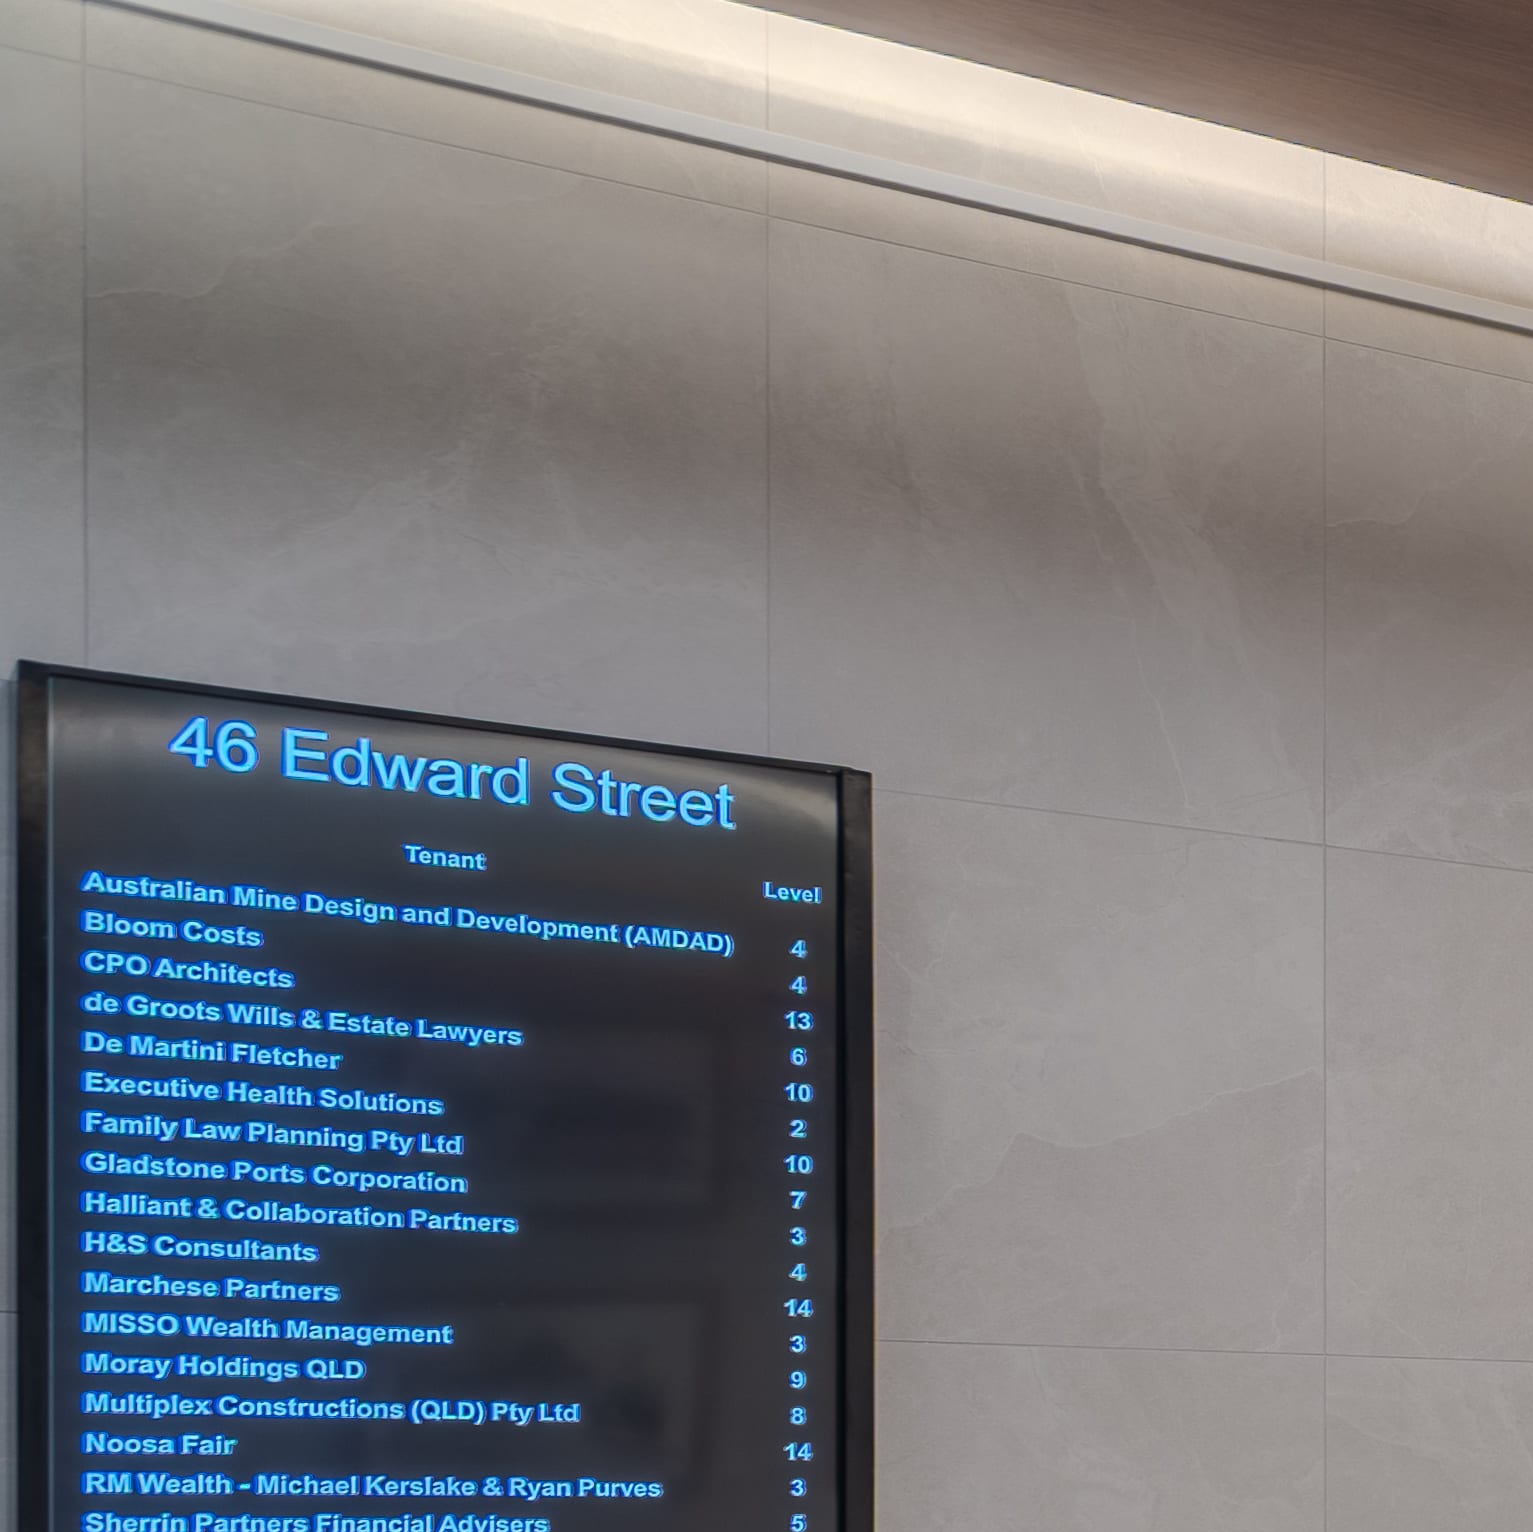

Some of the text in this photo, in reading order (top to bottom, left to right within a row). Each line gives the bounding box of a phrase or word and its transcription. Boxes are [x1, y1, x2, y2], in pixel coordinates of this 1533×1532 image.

[169, 717, 737, 830] 46 Edward Street
[404, 844, 487, 871] Tenant
[764, 881, 821, 904] Level
[82, 871, 735, 958] Australian Mine Design and Development (AMDAD)
[84, 910, 261, 947] Bloom Costs
[790, 939, 807, 958] 4
[84, 950, 294, 988] CPO Architects
[790, 975, 808, 994] 4
[84, 991, 523, 1047] de Groots Wills & Estate Lawyers
[785, 1010, 811, 1030] 13
[83, 1031, 342, 1070] De Martini Fletcher
[791, 1047, 808, 1066] 6
[84, 1071, 444, 1116] Executive Health Solutions
[785, 1082, 811, 1103] 10
[85, 1111, 463, 1156] Family Law Planning Pty Ltd
[790, 1119, 807, 1138] 2
[85, 1151, 468, 1194] Gladstone Ports Corporation
[784, 1154, 813, 1174] 10
[84, 1191, 519, 1233] Halliant & Collaboration Partners
[790, 1190, 807, 1210] 7
[84, 1231, 317, 1263] H&S Consultants
[789, 1226, 807, 1246] 3
[789, 1263, 807, 1282] 4
[83, 1271, 340, 1302] Marchese Partners
[783, 1298, 814, 1318] 14
[83, 1312, 453, 1347] MISSO Wealth Management
[789, 1335, 807, 1353] 3
[84, 1352, 364, 1383] Moray Holdings QLD
[790, 1371, 807, 1389] 9
[84, 1392, 580, 1426] Multiplex Constructions (QLD) Pty Ltd
[790, 1407, 807, 1425] 8
[85, 1431, 239, 1456] Noosa Fair
[783, 1442, 812, 1461] 14
[85, 1472, 133, 1494] RM
[136, 1472, 234, 1495] Wealth
[255, 1474, 357, 1496] Michael
[365, 1475, 477, 1497] Kerslake
[482, 1476, 505, 1497] &
[508, 1476, 572, 1501] Ryan
[577, 1478, 664, 1498] Purves
[790, 1478, 807, 1497] 3
[791, 1513, 807, 1532] 5
